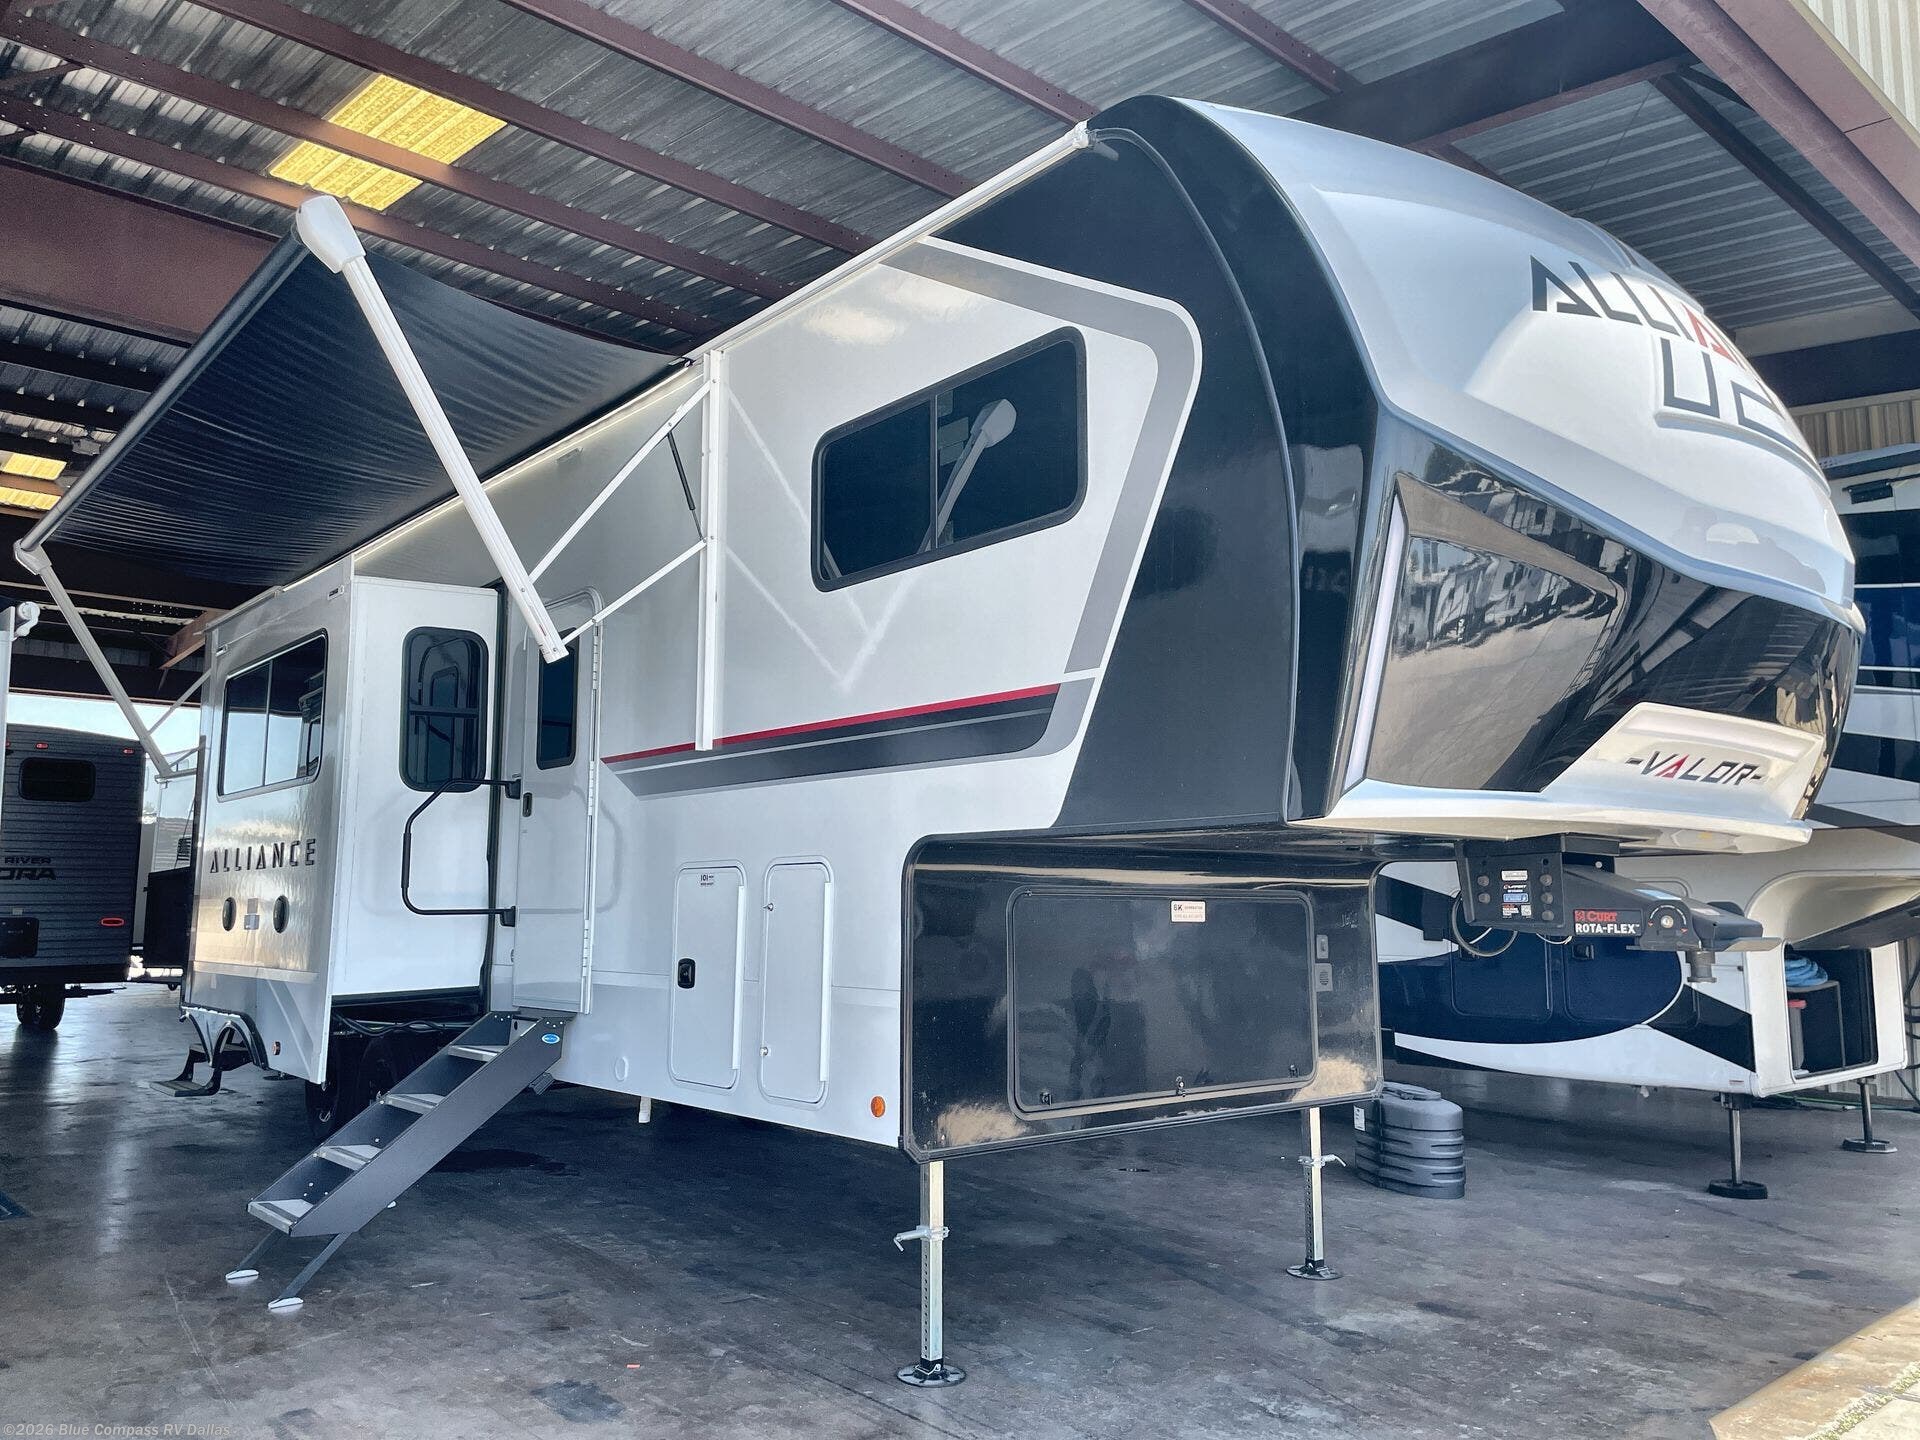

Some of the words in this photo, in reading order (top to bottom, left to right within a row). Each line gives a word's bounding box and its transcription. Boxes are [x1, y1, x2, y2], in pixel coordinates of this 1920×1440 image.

[4, 856, 52, 864] RIVER
[210, 838, 316, 874] ALLIANCE
[1586, 910, 1617, 922] CURT
